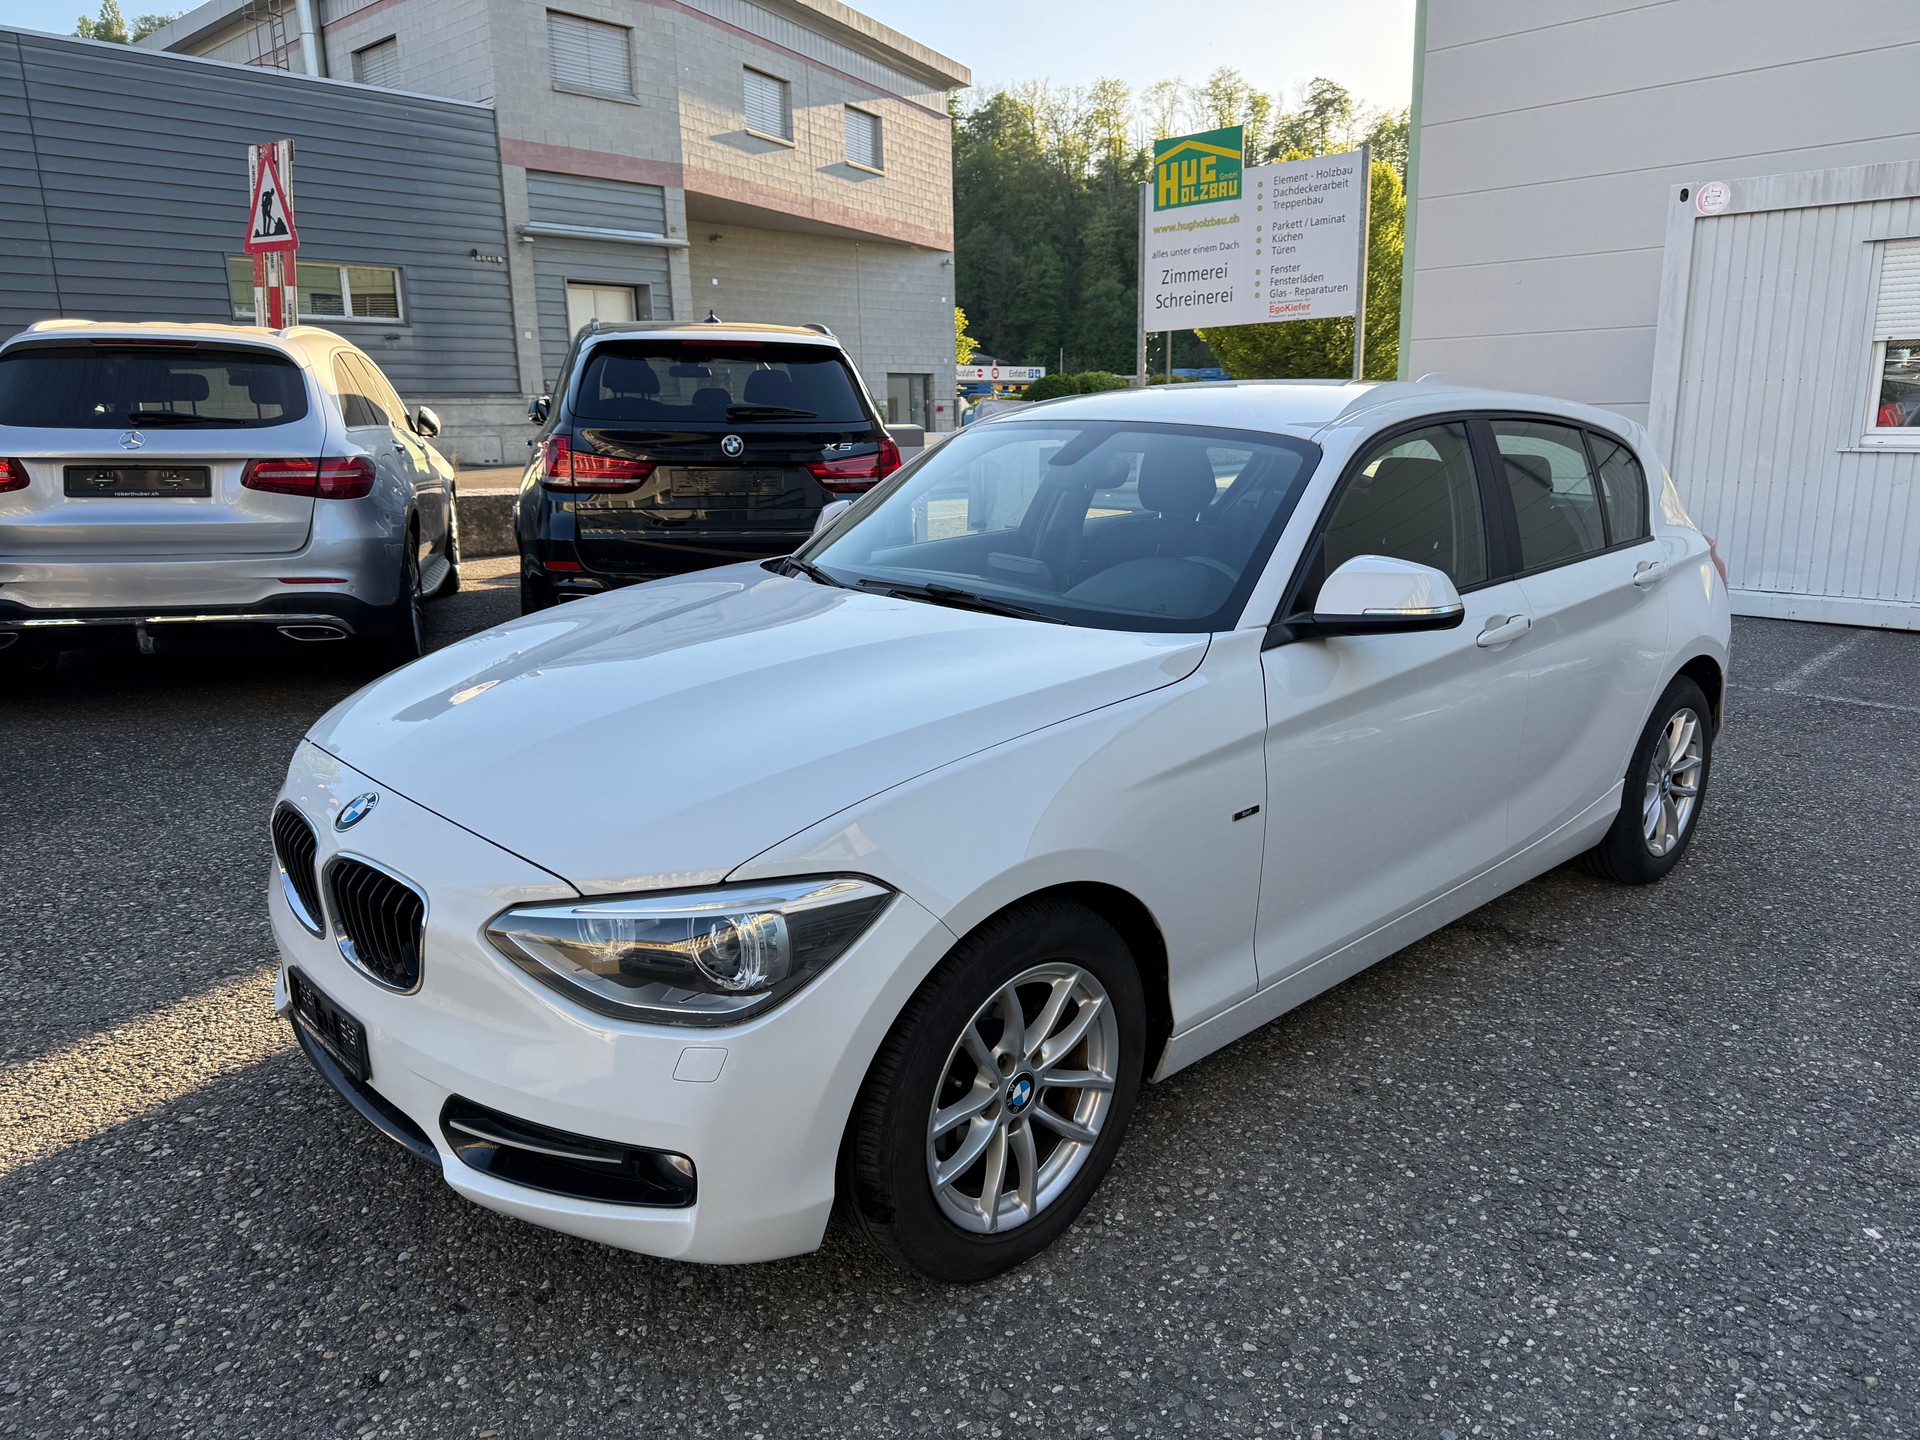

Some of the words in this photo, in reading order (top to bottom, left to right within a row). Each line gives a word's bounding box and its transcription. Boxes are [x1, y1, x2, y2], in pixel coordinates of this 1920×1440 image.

[1158, 156, 1217, 207] HUG
[1220, 171, 1238, 180] GmbH
[1273, 173, 1308, 186] Element
[1316, 167, 1353, 179] Holzbau
[1273, 179, 1349, 198] Dachdeckerarbeit
[1273, 196, 1324, 210] Treppenbau
[1153, 213, 1240, 234] www.hugholzbau.ch
[1272, 220, 1303, 231] Parkett
[1310, 214, 1346, 227] Laminat
[1271, 232, 1303, 243] Küchen
[1152, 250, 1169, 259] alles
[1170, 247, 1191, 257] unter
[1193, 244, 1217, 254] einem
[1219, 240, 1240, 251] Dach
[1271, 245, 1296, 255] Türen
[1161, 262, 1228, 285] Zimmerei
[1270, 264, 1301, 275] Fenster
[1270, 273, 1324, 286] Fensterläden
[1156, 286, 1233, 309] Schreinerei
[1269, 288, 1287, 298] Glas
[1294, 284, 1349, 297] Reparaturen
[1269, 302, 1311, 314] EgoKiefer
